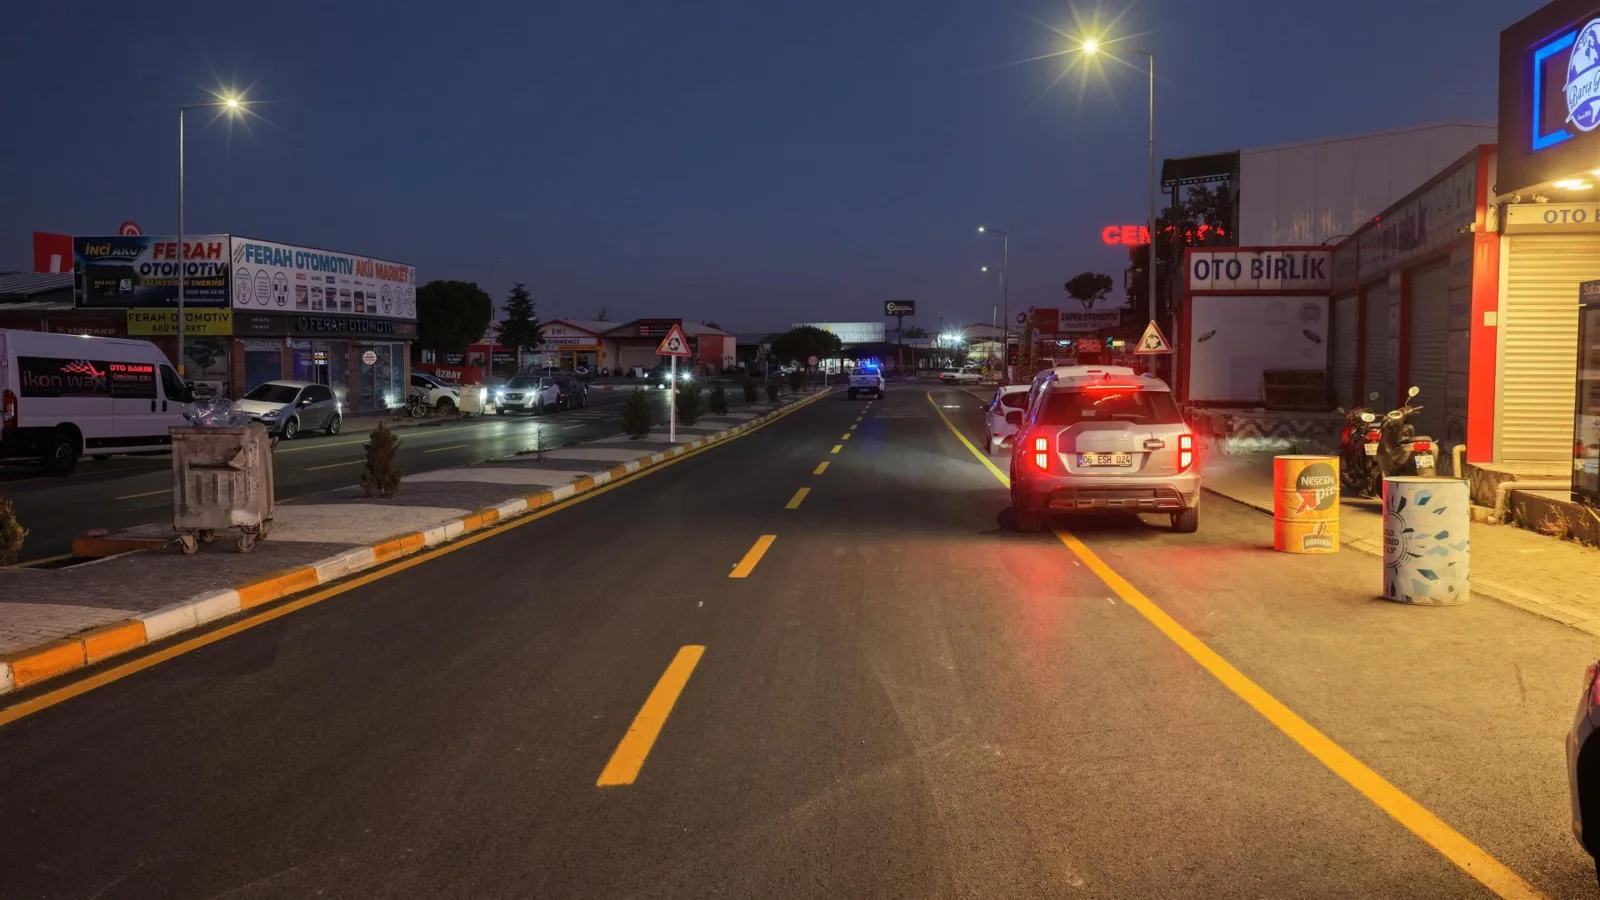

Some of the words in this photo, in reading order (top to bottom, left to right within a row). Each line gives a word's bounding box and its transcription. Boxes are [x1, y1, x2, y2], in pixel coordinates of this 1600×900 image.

[1543, 208, 1587, 224] OTO
[153, 242, 222, 259] FERAH
[140, 262, 225, 276] OTOMOTİV
[245, 243, 293, 268] FERAH
[356, 259, 374, 278] AKÜ
[376, 264, 409, 283] MARKET
[1193, 258, 1242, 281] OTO
[1251, 255, 1326, 280] BİRLİK
[128, 313, 166, 322] FERAH
[310, 316, 344, 332] FERAH
[152, 324, 170, 332] AKÜ
[172, 324, 207, 332] MRKET
[110, 364, 126, 372] OTO
[128, 365, 153, 373] BAKIM
[435, 368, 461, 379] ÖZBAY
[23, 371, 62, 387] ikon
[1083, 456, 1093, 464] 06
[1097, 456, 1112, 464] ESH
[1116, 456, 1130, 464] 024
